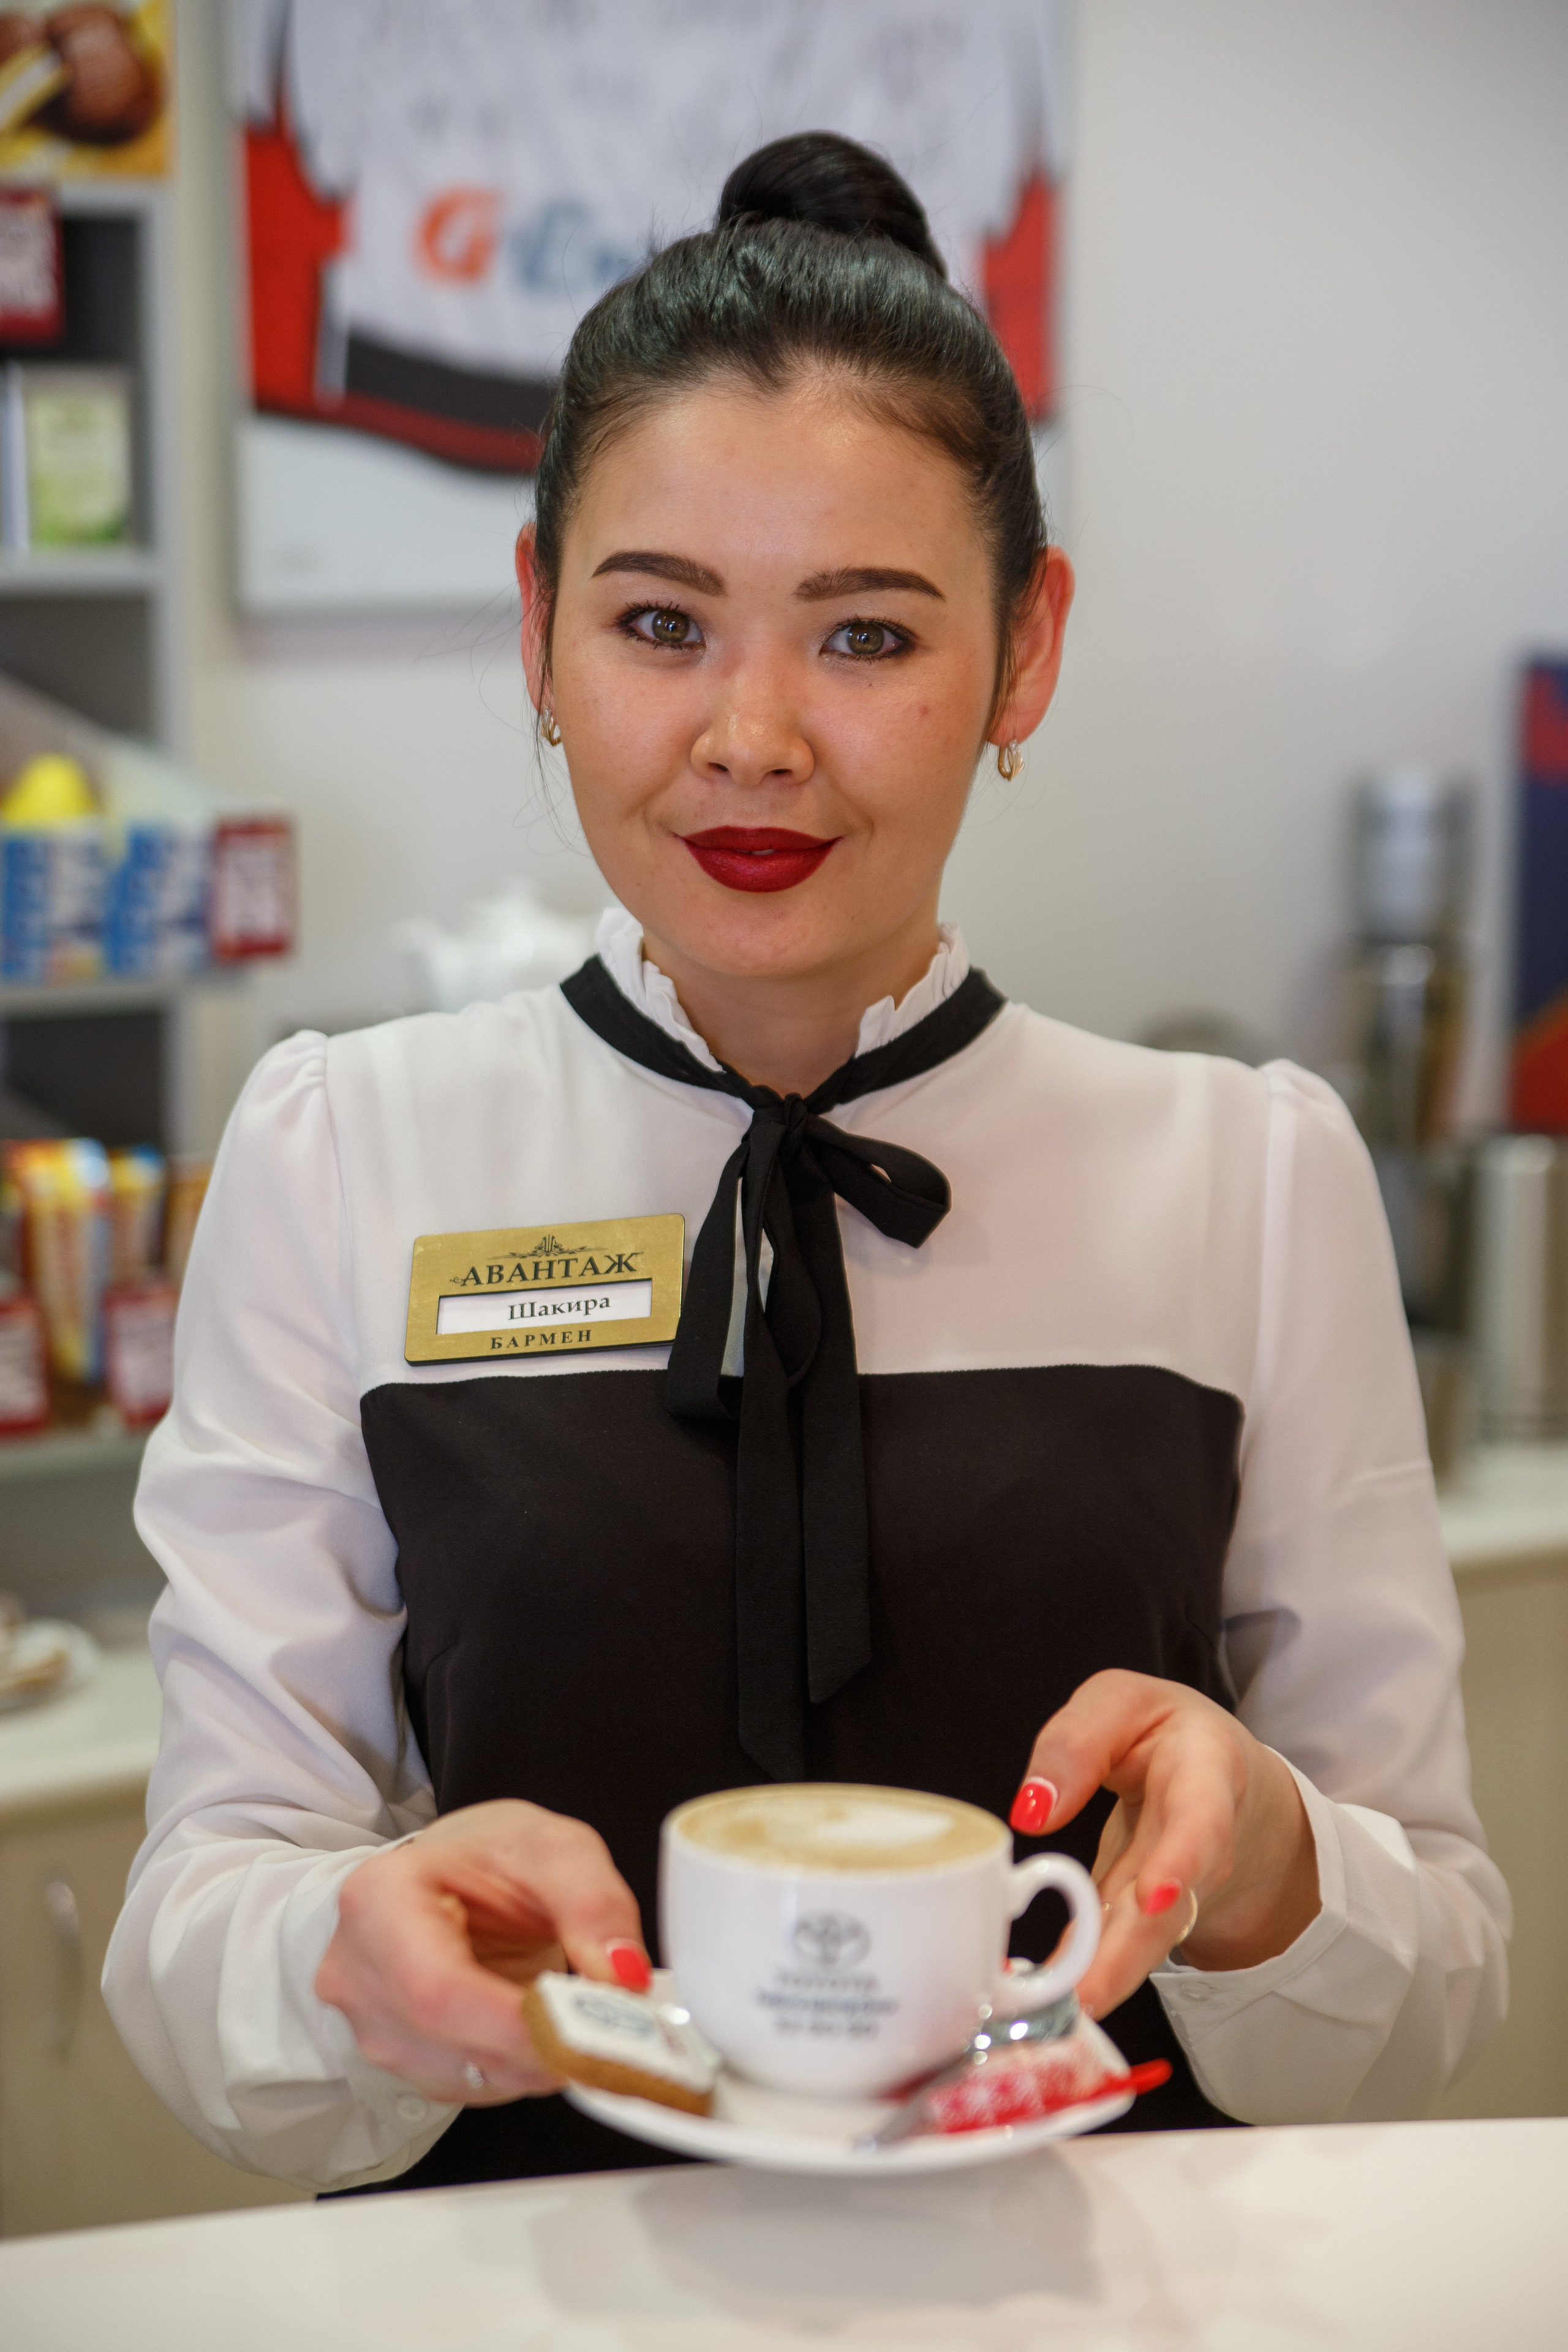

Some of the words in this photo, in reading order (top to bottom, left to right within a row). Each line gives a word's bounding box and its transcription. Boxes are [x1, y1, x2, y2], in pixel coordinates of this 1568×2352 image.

[452, 1251, 644, 1287] АВАНТАЖ
[507, 1296, 611, 1321] Шакира
[489, 1329, 593, 1350] БАРМЕН
